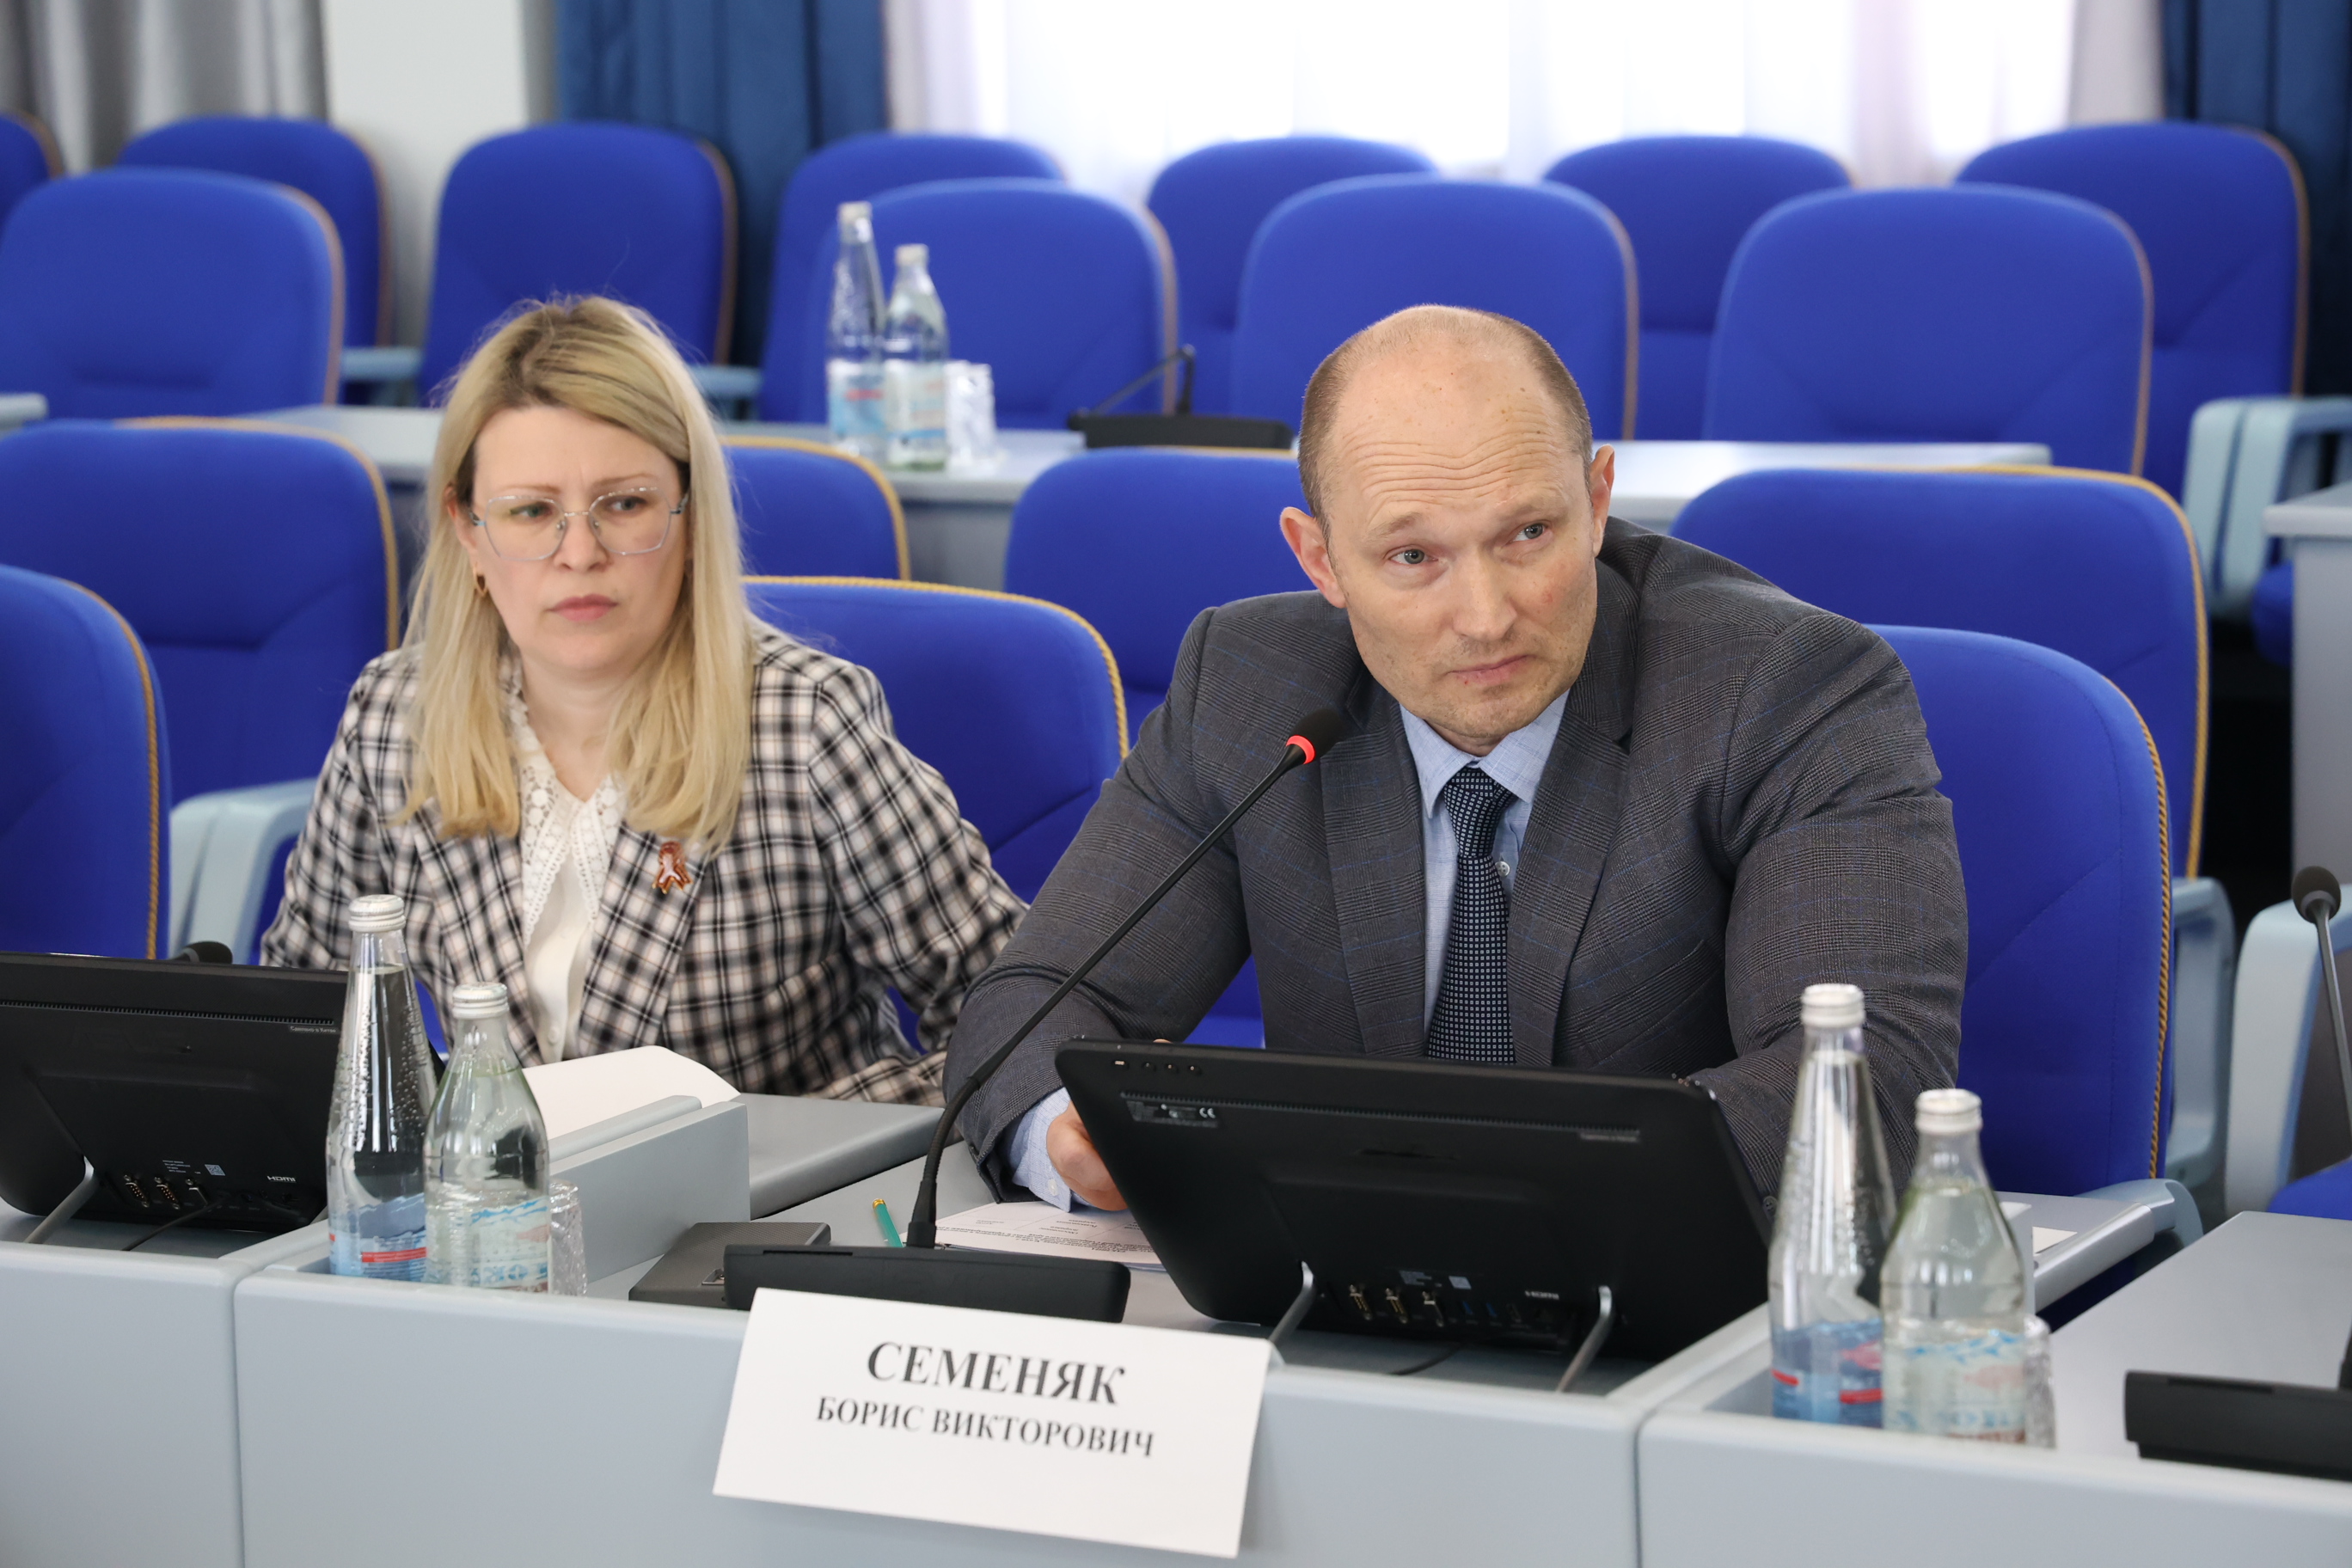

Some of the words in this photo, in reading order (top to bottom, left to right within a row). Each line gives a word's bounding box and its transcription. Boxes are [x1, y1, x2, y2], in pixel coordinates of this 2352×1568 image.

[266, 1174, 297, 1183] HDMI
[867, 1341, 1125, 1406] СЕМЕНЯК
[816, 1396, 924, 1431] БОРИС
[931, 1409, 1155, 1459] ВИКТОРОВИЧ
